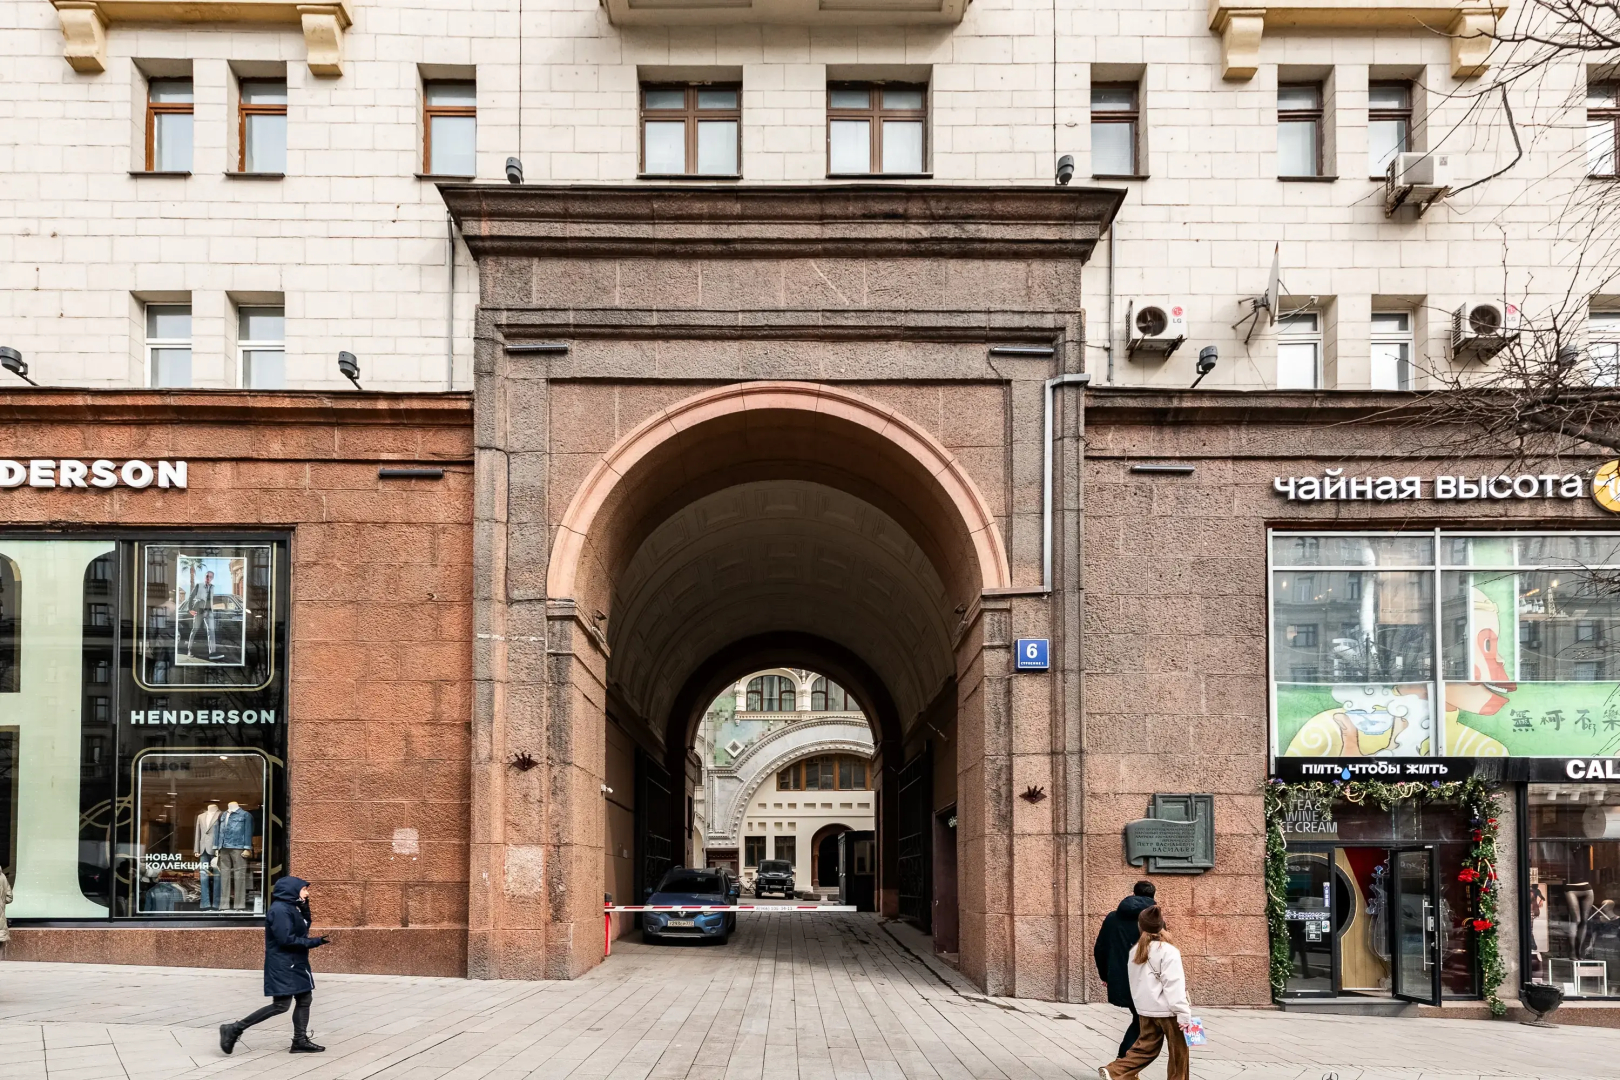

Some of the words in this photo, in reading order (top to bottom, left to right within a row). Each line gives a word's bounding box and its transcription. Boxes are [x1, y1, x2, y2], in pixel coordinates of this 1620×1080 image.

[0, 460, 188, 489] DERSON
[1274, 468, 1422, 500] чайная
[1434, 473, 1583, 499] высота
[1026, 643, 1038, 659] 6
[130, 709, 276, 725] HENDERSON
[1566, 759, 1620, 779] CAL
[1291, 799, 1312, 811] TEA
[1285, 810, 1319, 822] WINE
[1295, 821, 1338, 833] CREAM
[145, 853, 182, 861] НОВАЯ
[145, 862, 210, 871] КОЛЛЕКЦИЯ
